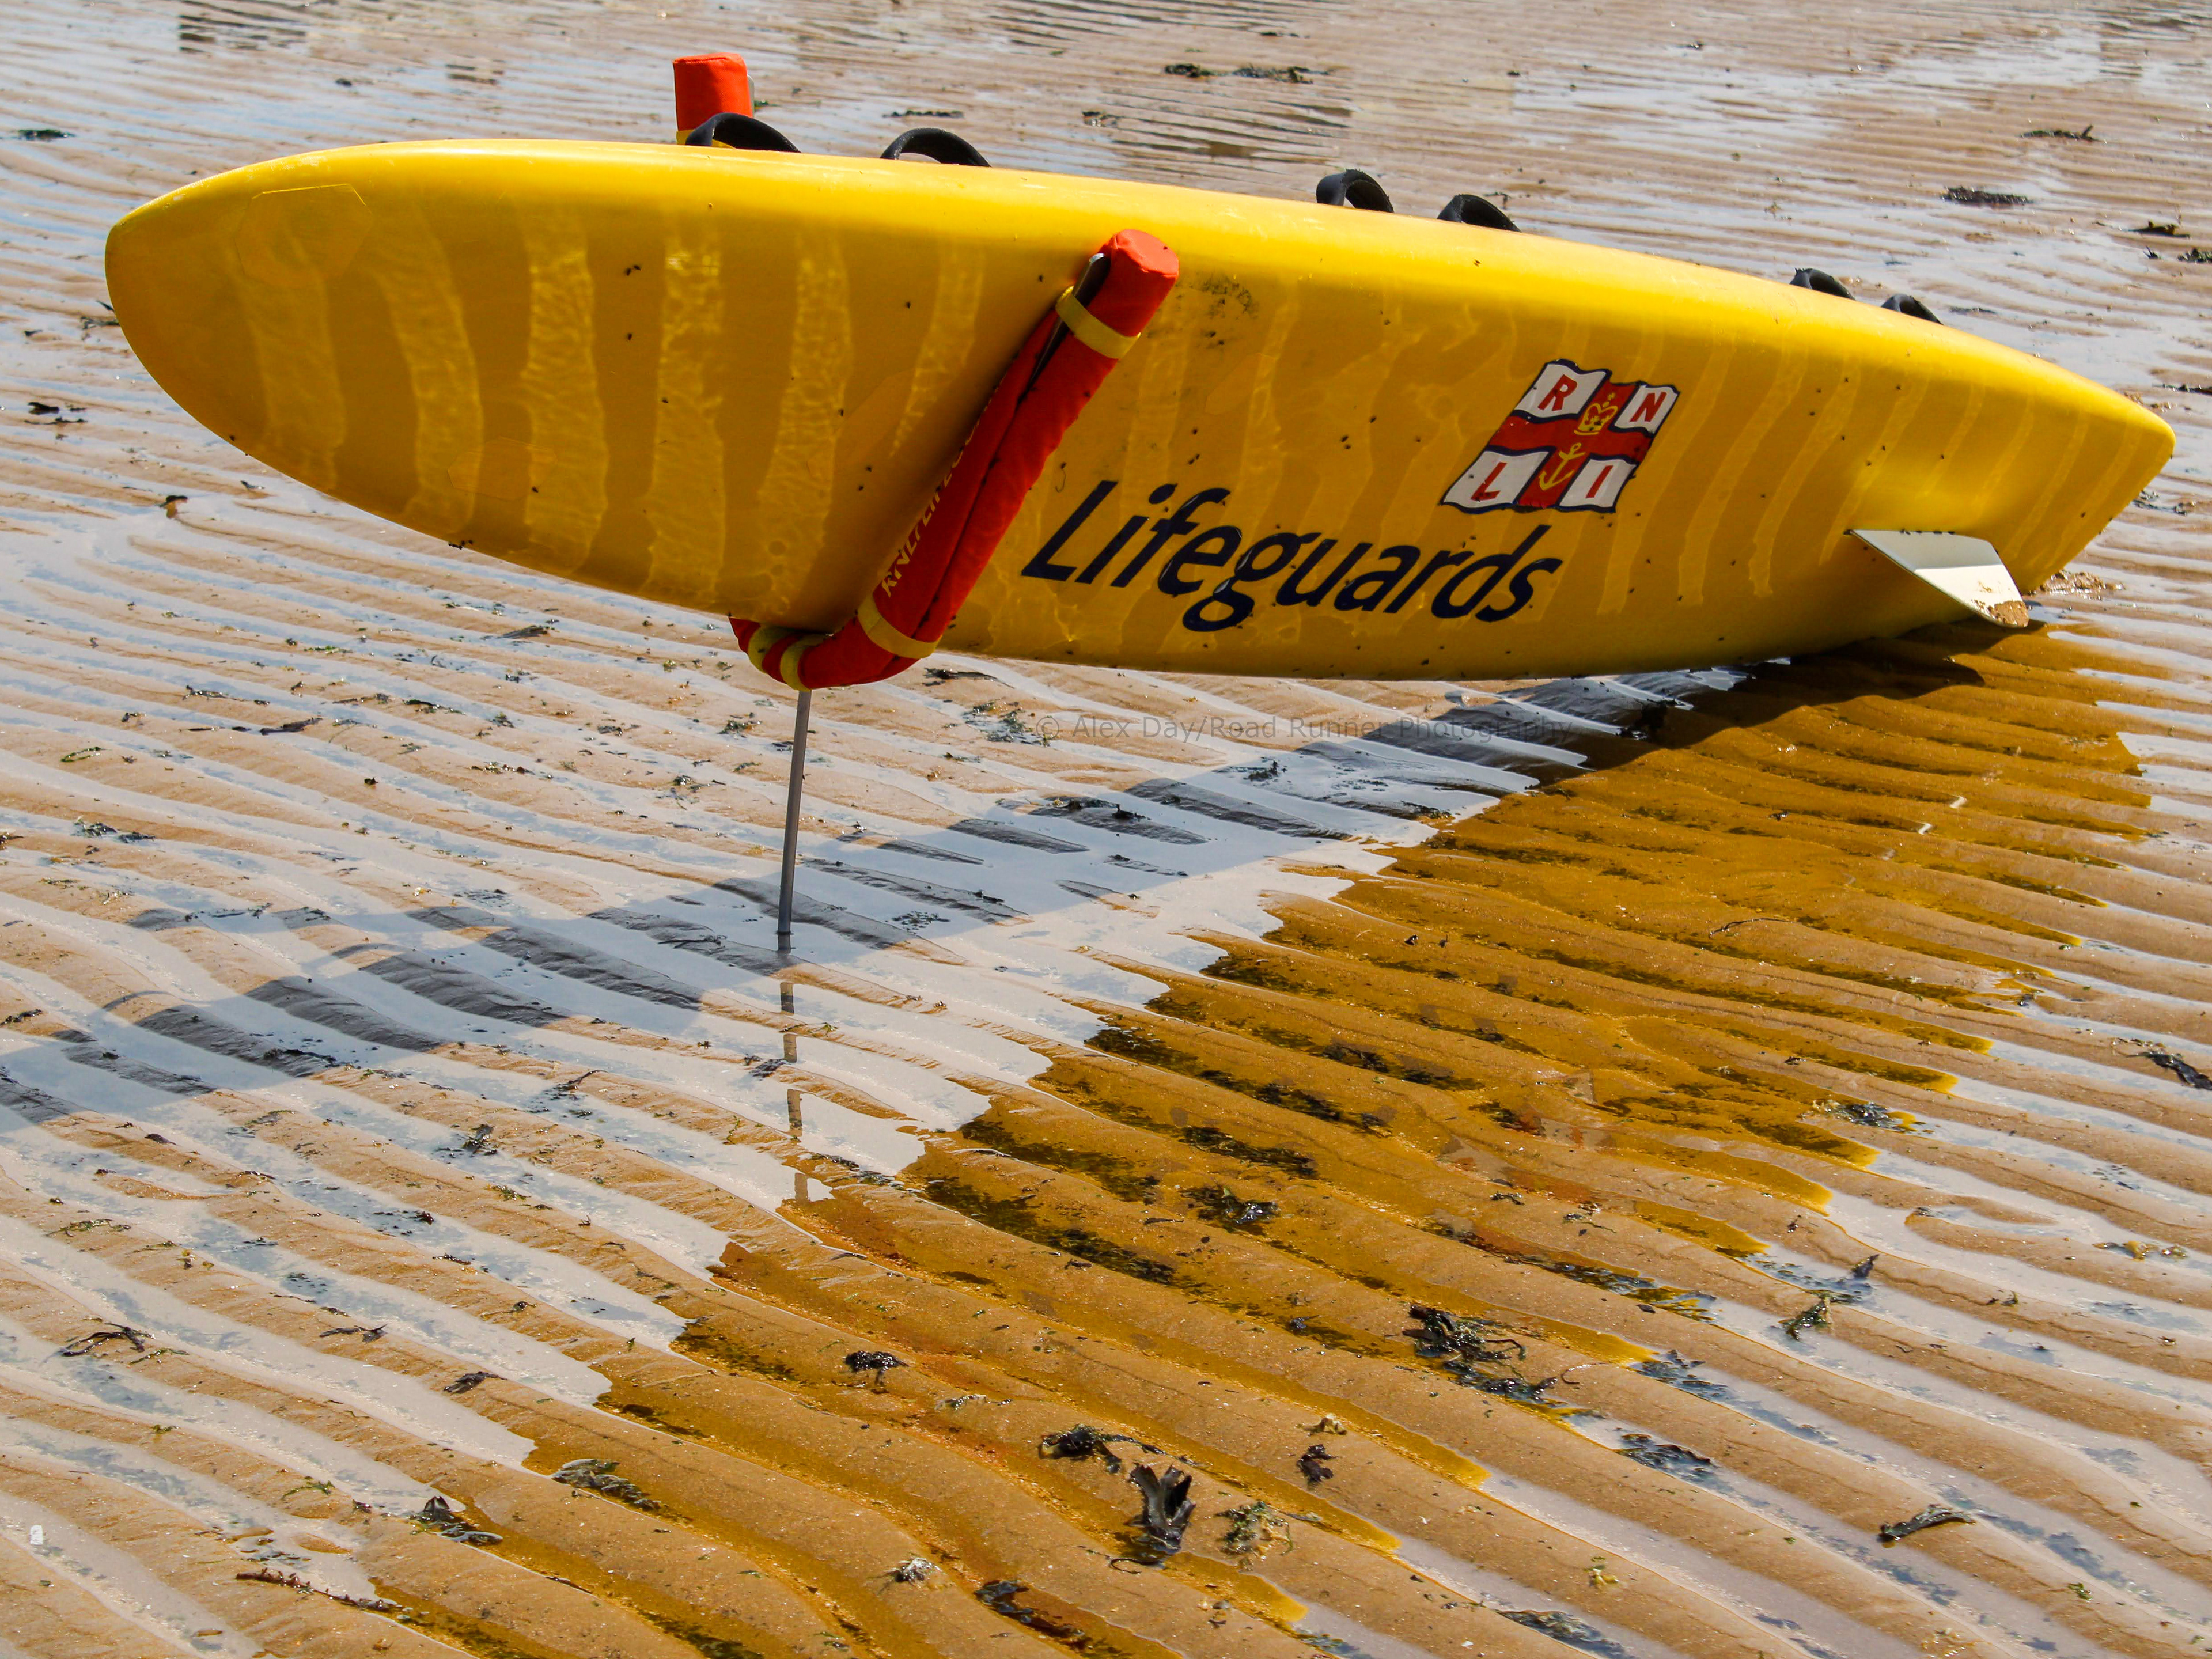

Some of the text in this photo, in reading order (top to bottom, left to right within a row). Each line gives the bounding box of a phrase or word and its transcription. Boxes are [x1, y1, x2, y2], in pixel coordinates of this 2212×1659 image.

[1537, 374, 1666, 422] R N
[1471, 462, 1613, 501] L I
[1021, 480, 1563, 631] Lifeguards
